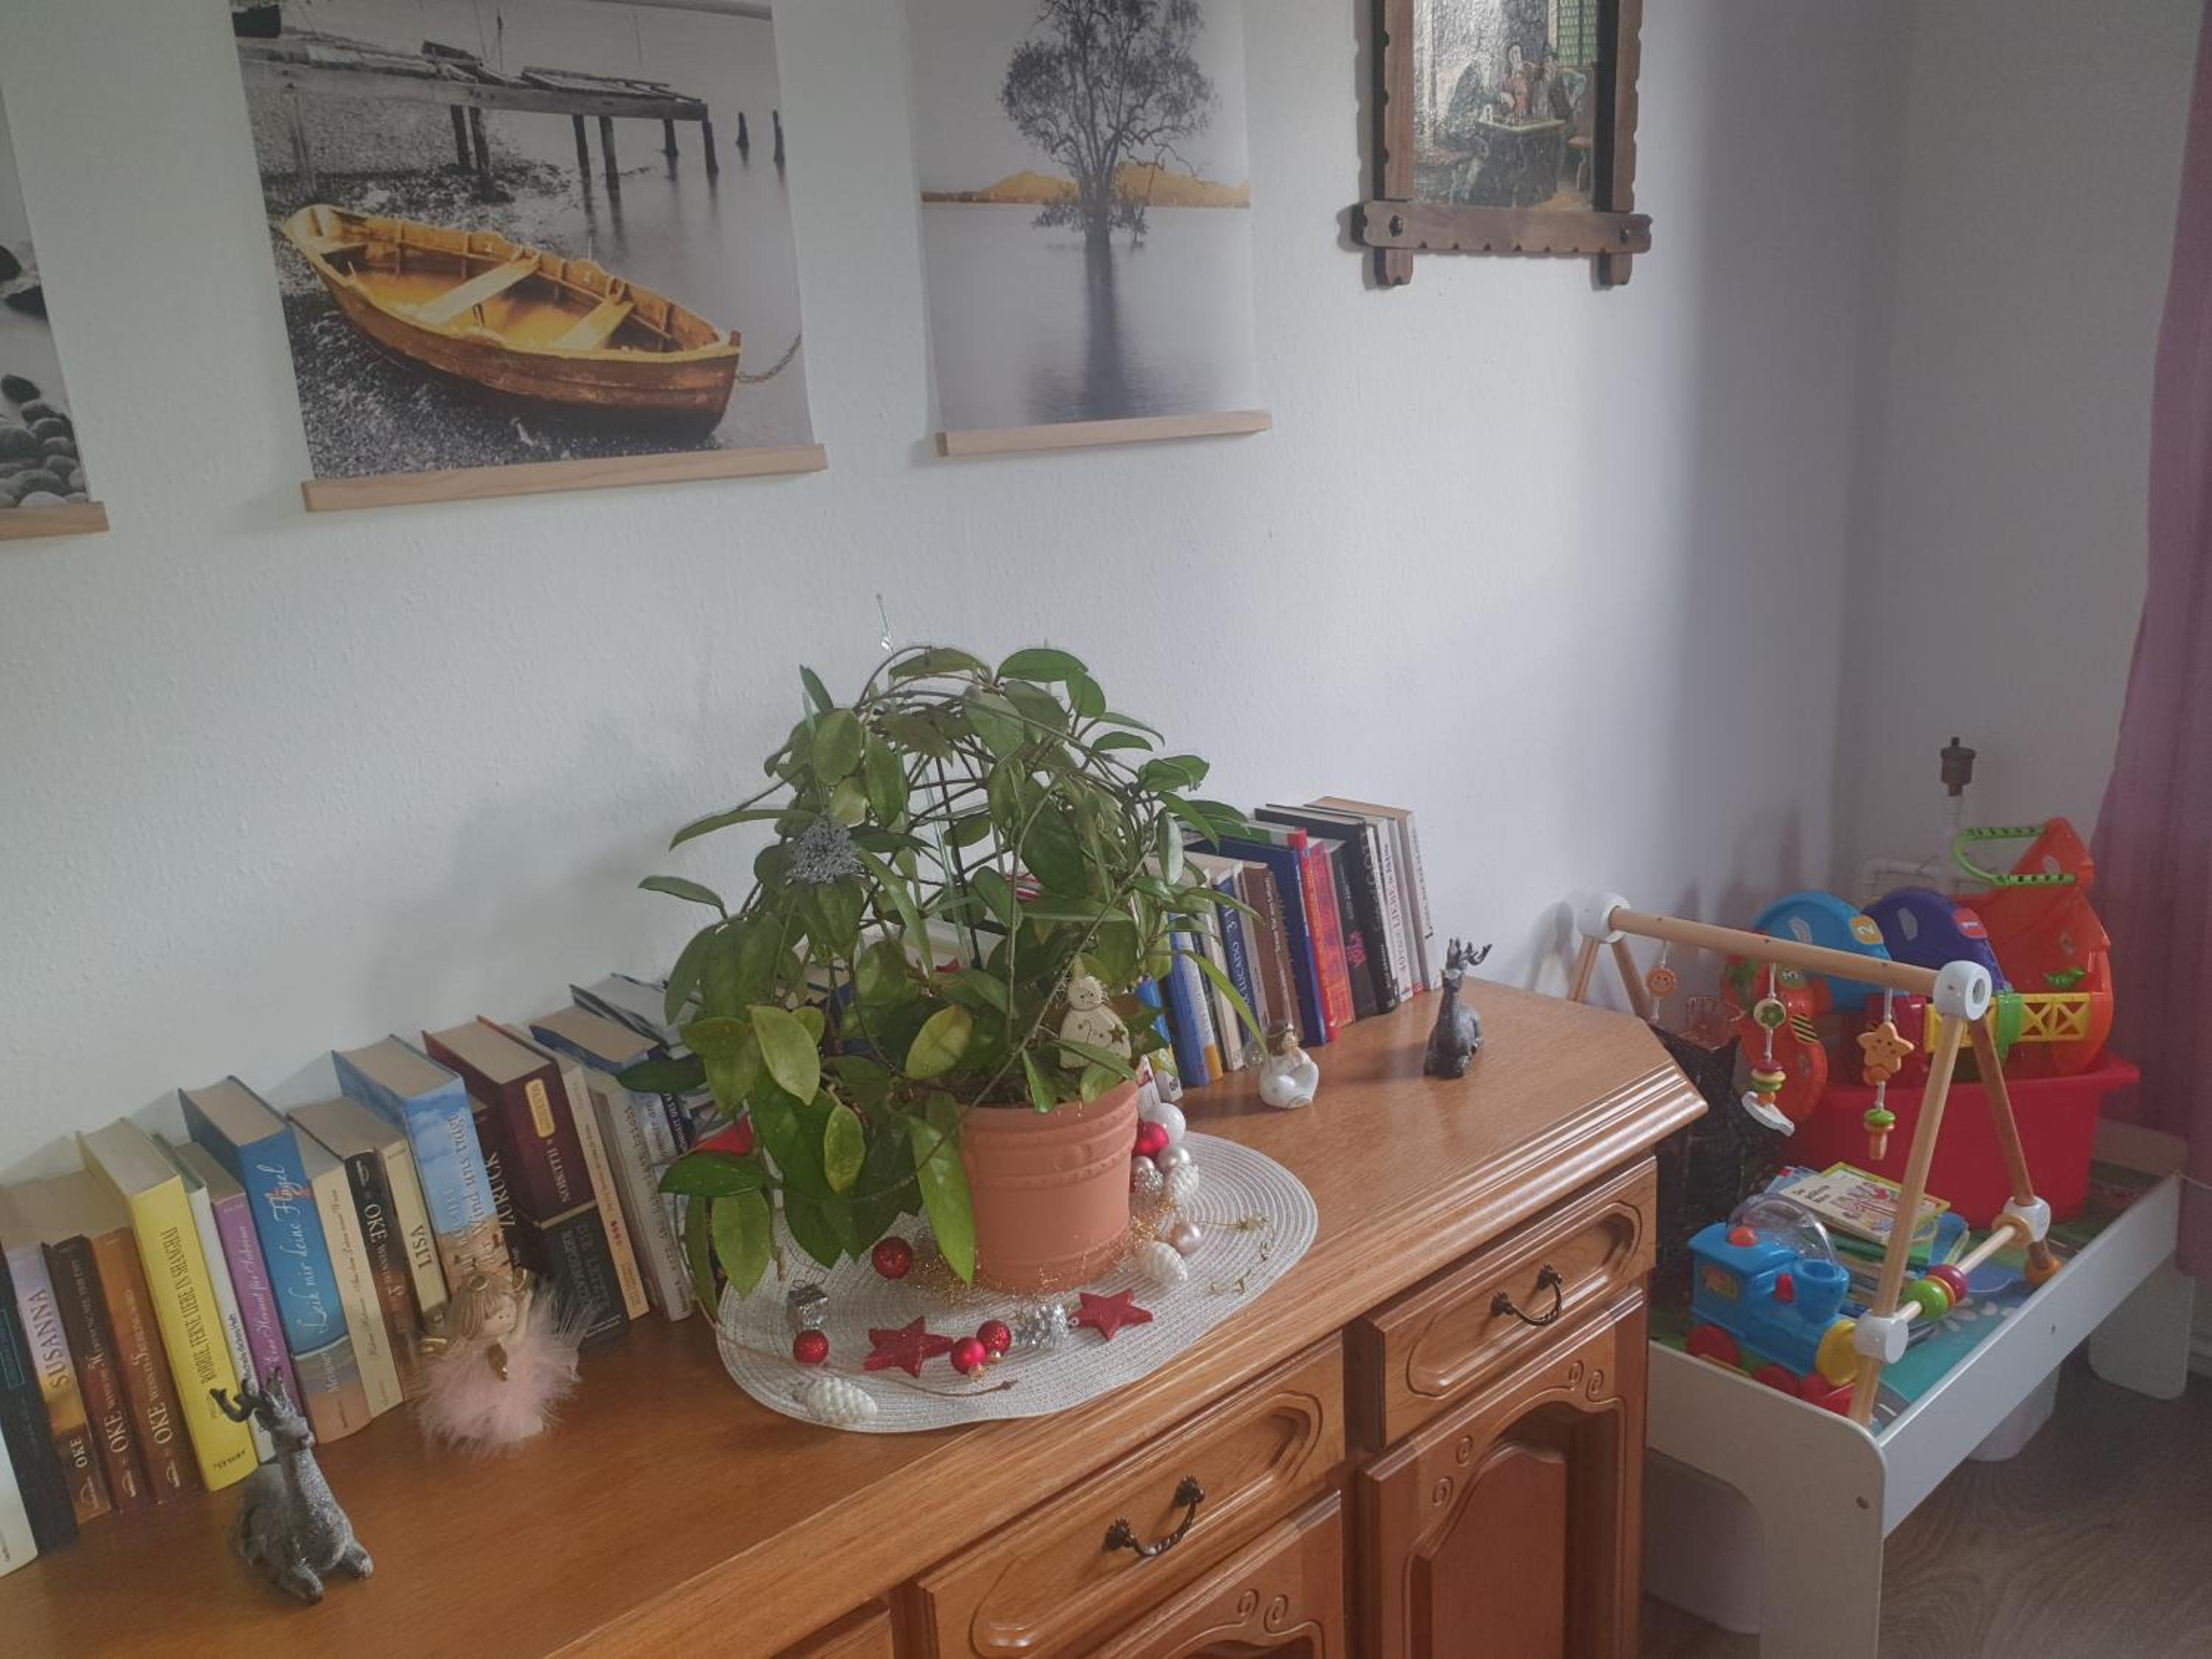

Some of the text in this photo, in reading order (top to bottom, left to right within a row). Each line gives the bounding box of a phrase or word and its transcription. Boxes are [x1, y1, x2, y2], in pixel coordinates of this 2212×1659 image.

[1228, 941, 1248, 992] LUCADO
[258, 1160, 307, 1222] Flügel
[457, 1157, 475, 1189] uns
[546, 1147, 571, 1203] ILLUSION
[362, 1201, 389, 1242] OKE
[459, 1192, 488, 1239] Wind
[281, 1221, 308, 1260] deine
[407, 1224, 434, 1268] LISA
[299, 1260, 316, 1287] mir
[24, 1287, 72, 1389] SUSANNA
[101, 1409, 131, 1454] OKE
[145, 1400, 174, 1445] OKE
[69, 1437, 89, 1470] OKE
